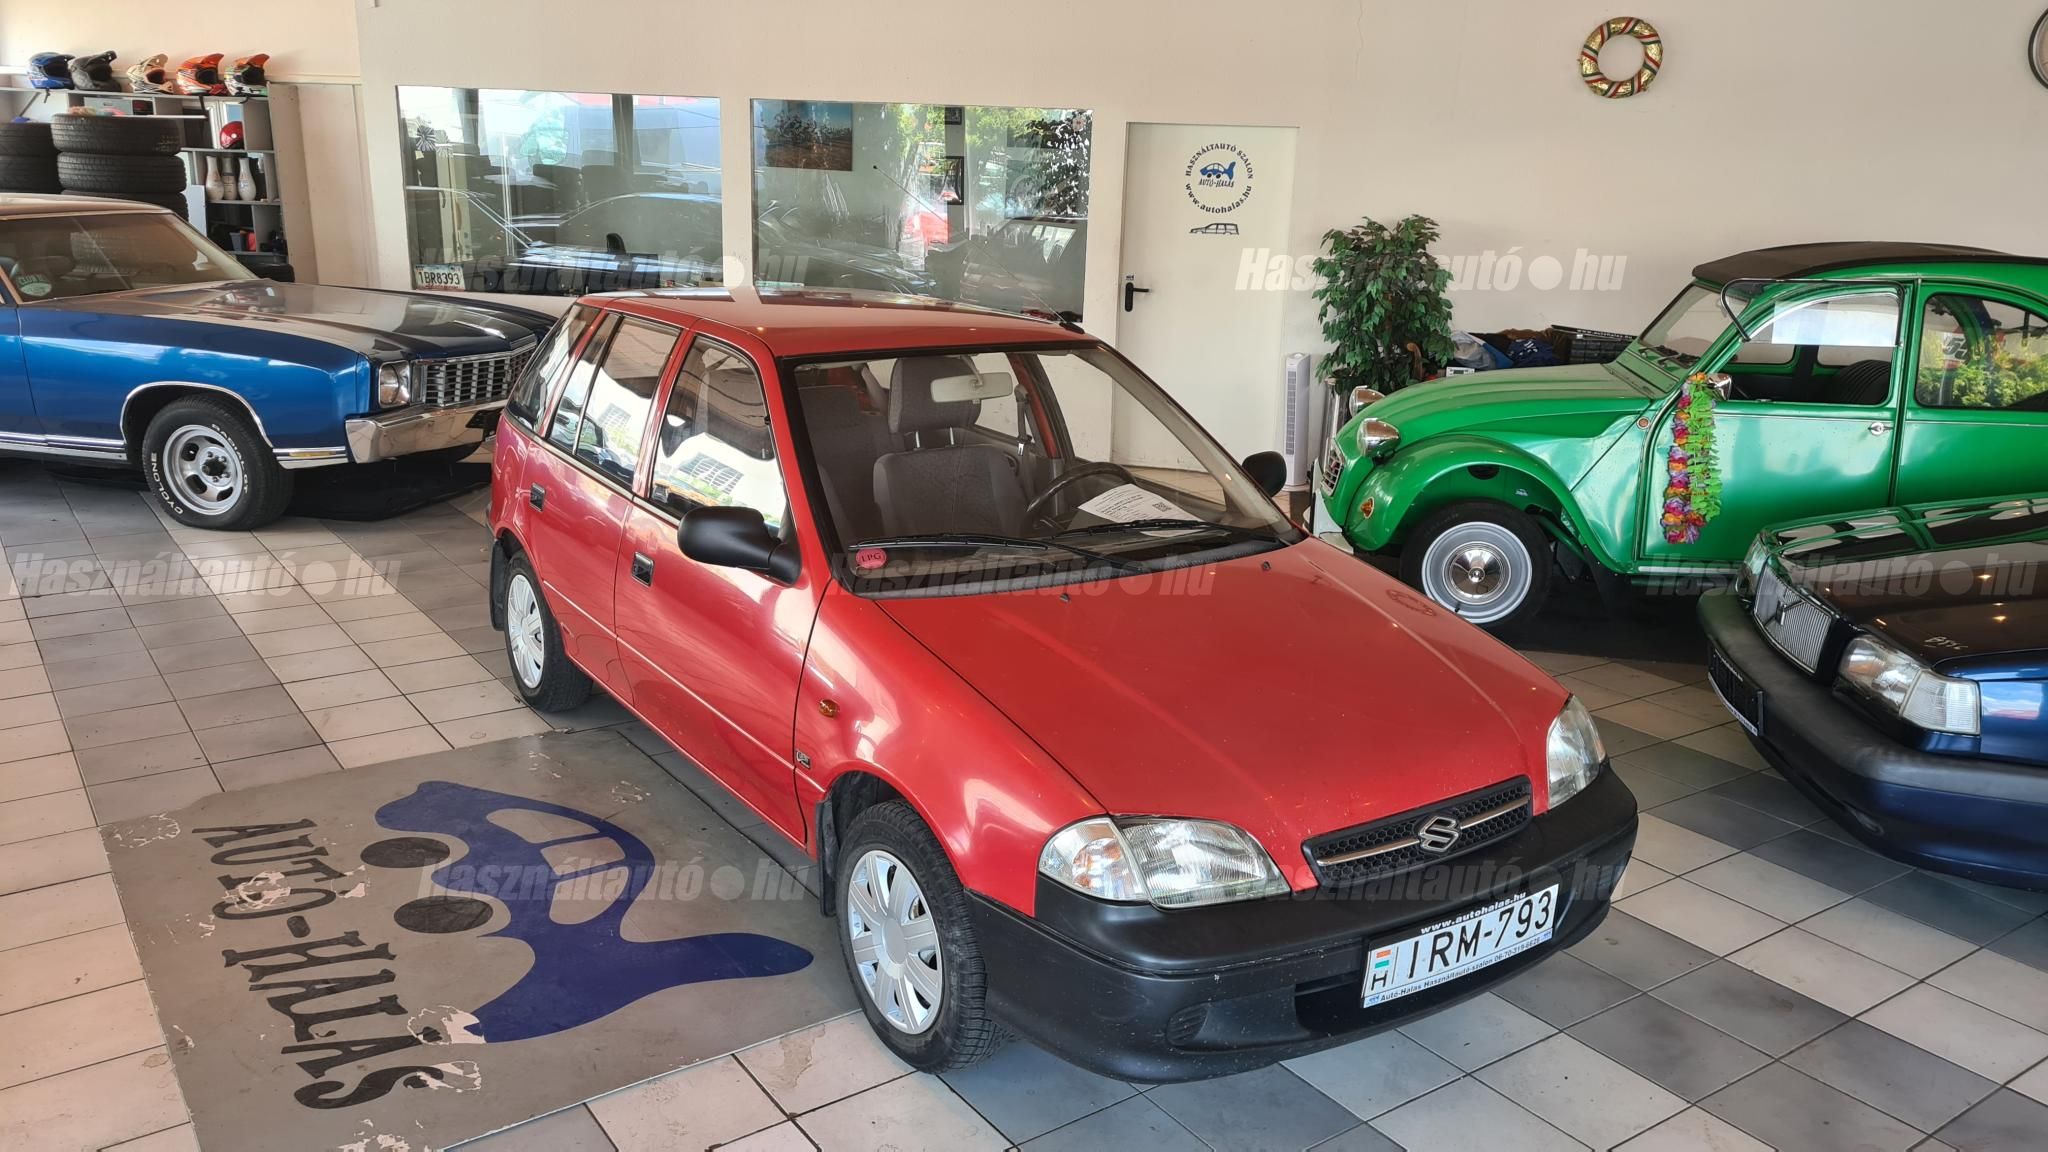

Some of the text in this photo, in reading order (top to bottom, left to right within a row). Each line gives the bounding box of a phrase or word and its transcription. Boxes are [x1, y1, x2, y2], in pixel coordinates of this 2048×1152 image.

[1185, 142, 1254, 179] HASZNÁLTAUTÓ SZALON
[1185, 183, 1252, 214] www.autohalas.hu
[418, 271, 460, 285] 1BR8393
[151, 452, 184, 515] CYCLONE
[1420, 891, 1526, 934] www.autohalas.hu
[1370, 890, 1551, 991] H IRM-793
